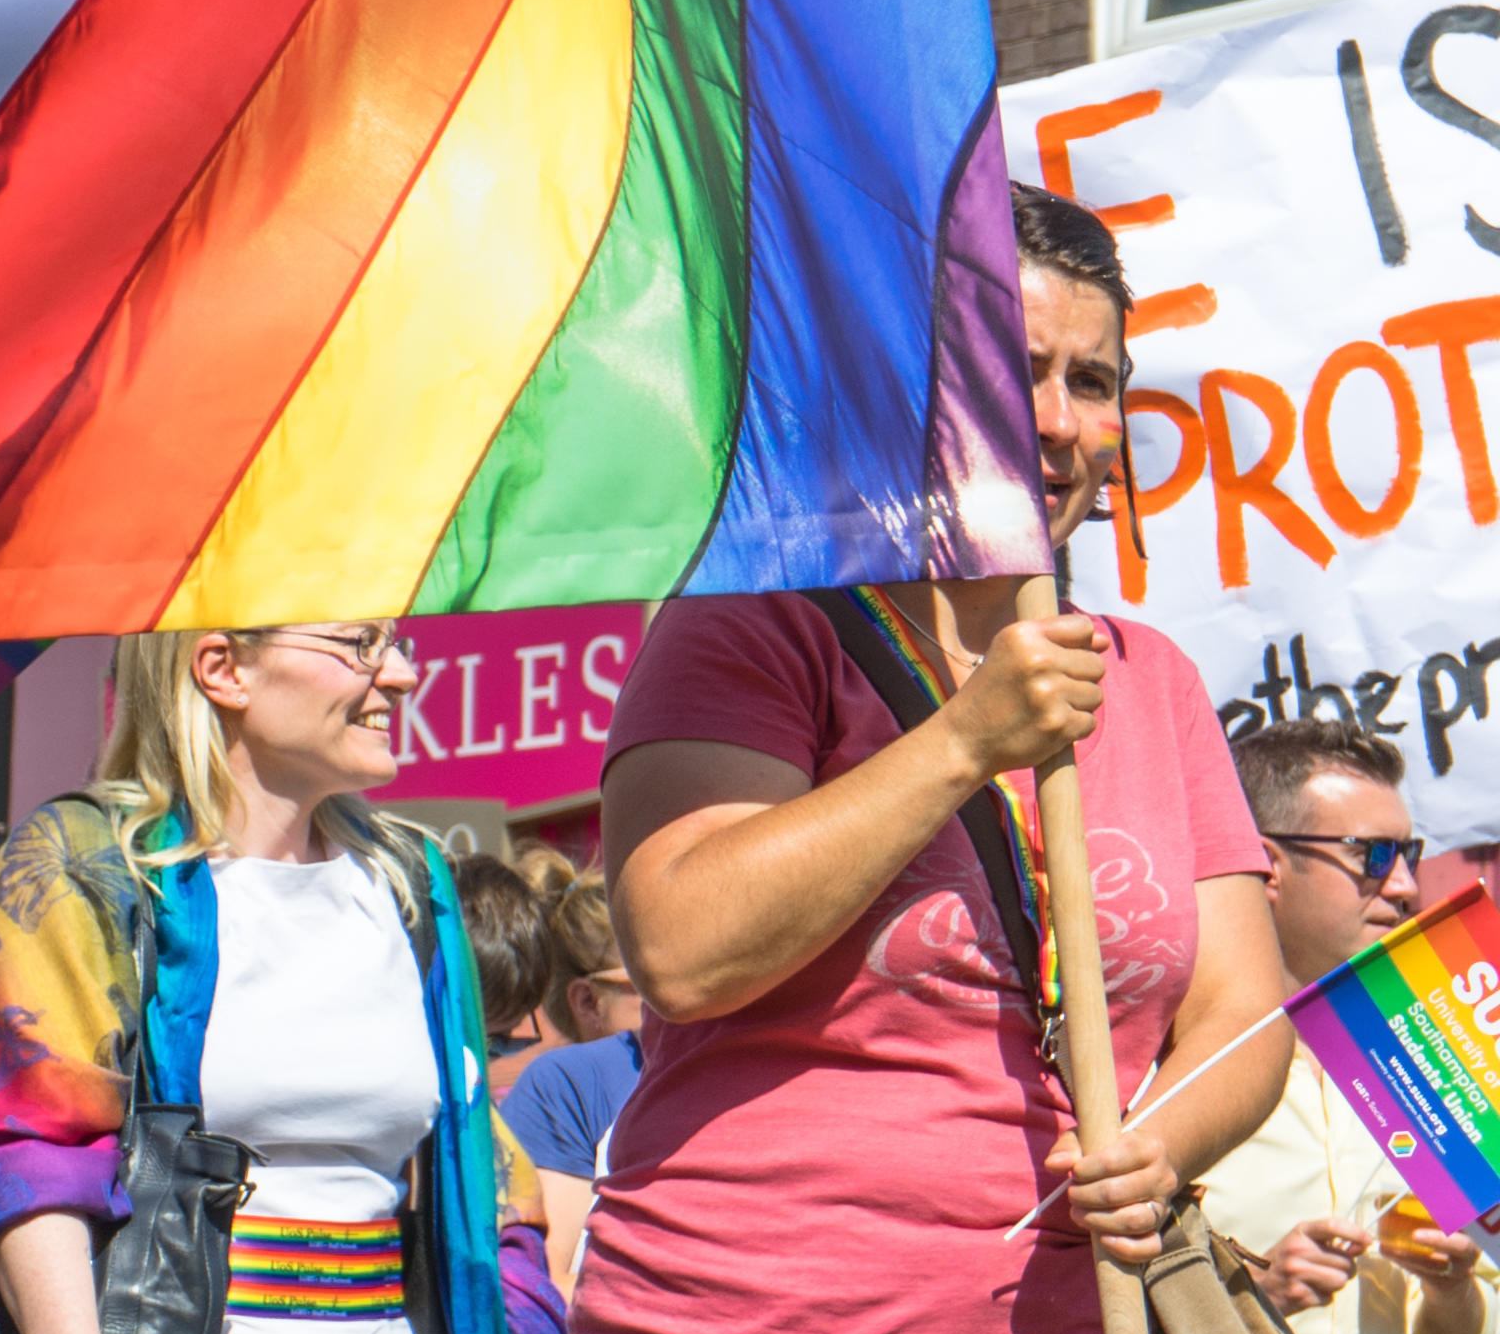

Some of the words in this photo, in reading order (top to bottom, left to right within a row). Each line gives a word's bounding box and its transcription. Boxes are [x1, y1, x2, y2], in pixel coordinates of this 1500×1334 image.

[1428, 987, 1488, 1070] University
[1451, 961, 1500, 1059] SU
[1388, 1013, 1452, 1091] Students'
[1443, 1091, 1484, 1145] Union
[1389, 1055, 1448, 1136] www.susu.org
[1408, 1001, 1489, 1113] Southampton
[1368, 1100, 1389, 1128] Society
